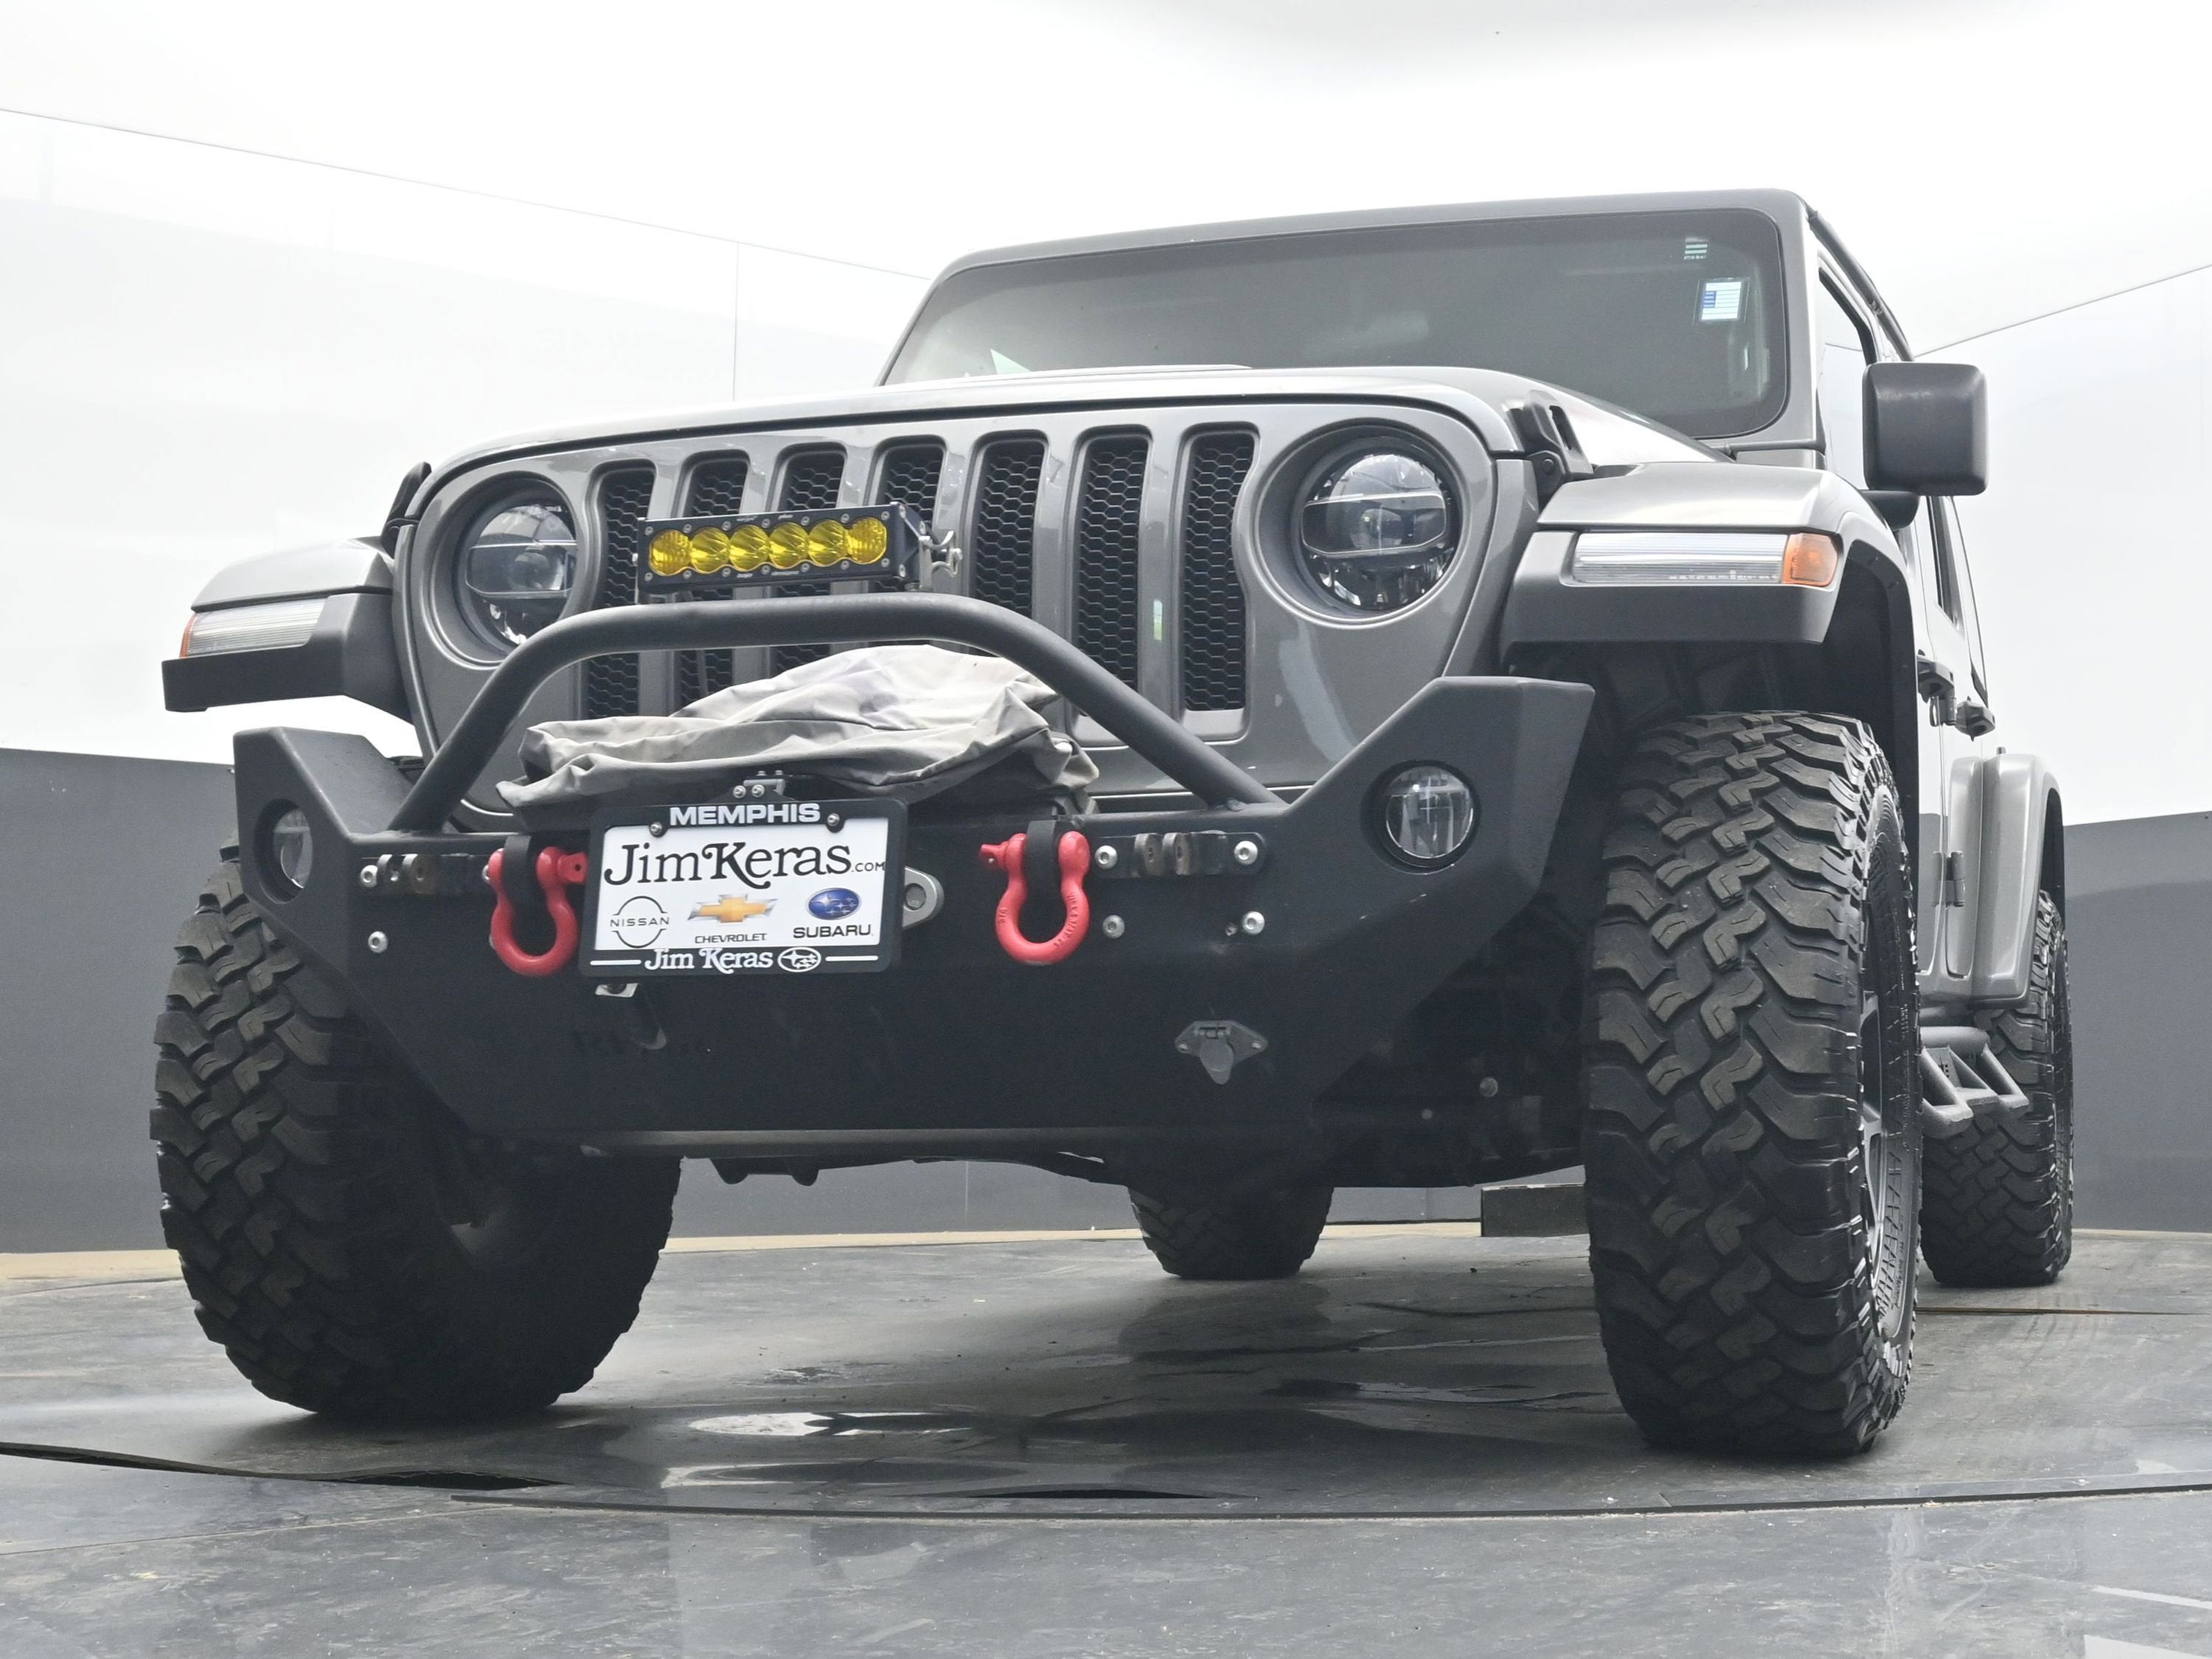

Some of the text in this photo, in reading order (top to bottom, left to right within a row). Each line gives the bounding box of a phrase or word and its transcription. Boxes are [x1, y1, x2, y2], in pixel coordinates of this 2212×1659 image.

[669, 803, 821, 827] MEMPHIS
[610, 917, 670, 927] NISSAN
[695, 933, 768, 944] CHEVROLET
[793, 924, 872, 939] SUBARU
[644, 947, 773, 974] Jim Keras
